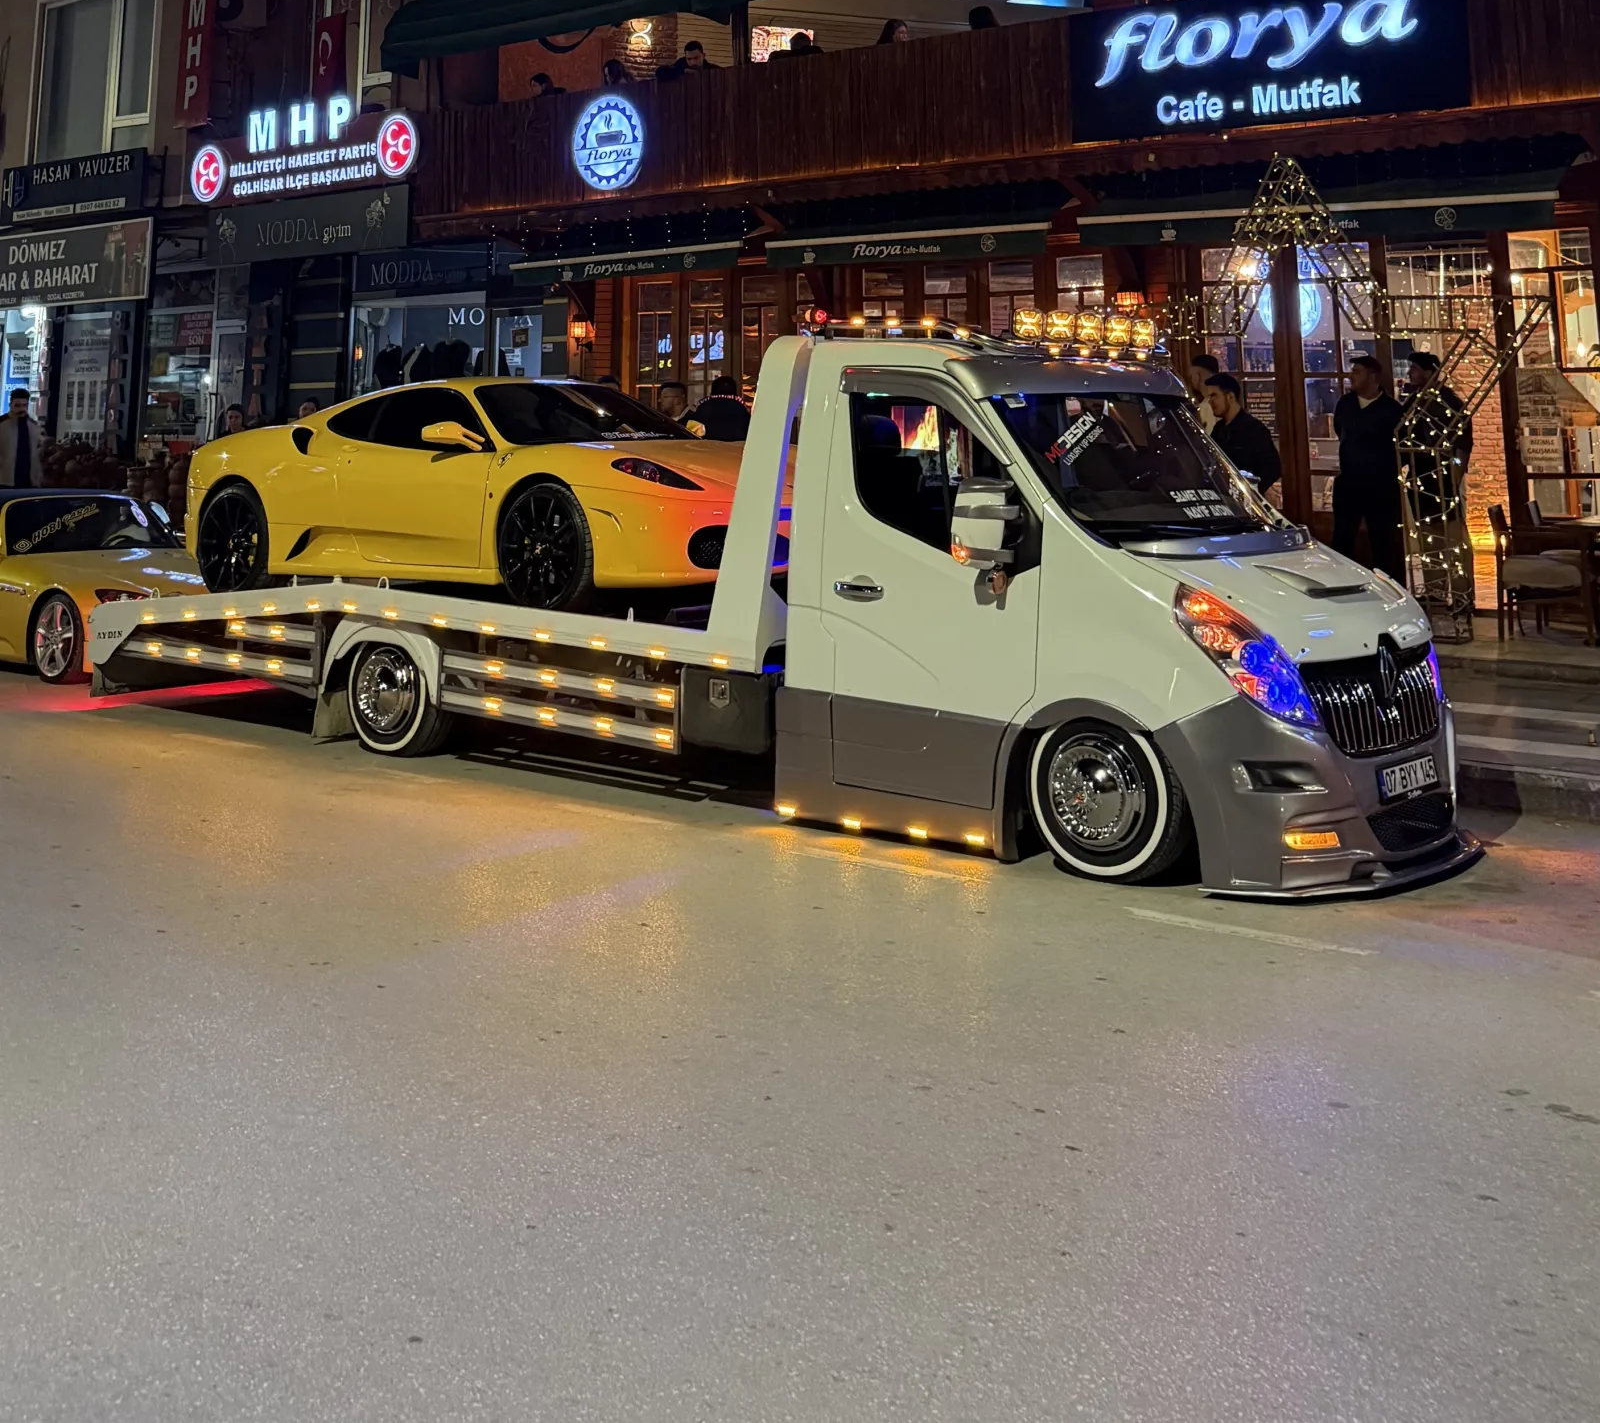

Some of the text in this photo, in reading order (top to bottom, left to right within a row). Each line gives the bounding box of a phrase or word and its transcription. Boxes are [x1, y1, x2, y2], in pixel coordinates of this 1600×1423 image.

[1156, 91, 1224, 125] Cafe
[1252, 76, 1362, 115] Mutfak
[249, 96, 352, 153] MHP
[229, 155, 286, 178] MİLLİYETÇİ
[288, 149, 336, 168] HAREKET
[586, 147, 632, 163] florya
[33, 155, 130, 185] HASAN YAVUZER
[233, 163, 377, 197] GÖLHİSAR İLÇE BAŞKANLIĞI
[257, 218, 352, 246] MODDA giyim
[8, 239, 67, 265] DÖNMEZ
[852, 243, 902, 258] florya
[919, 244, 941, 253] Mutfak
[0, 263, 98, 292] AR & BAHARAT
[371, 259, 434, 285] MODDA
[583, 263, 624, 277] florya
[97, 630, 123, 640] AYDIN
[1385, 758, 1436, 794] 07 BYY 145
